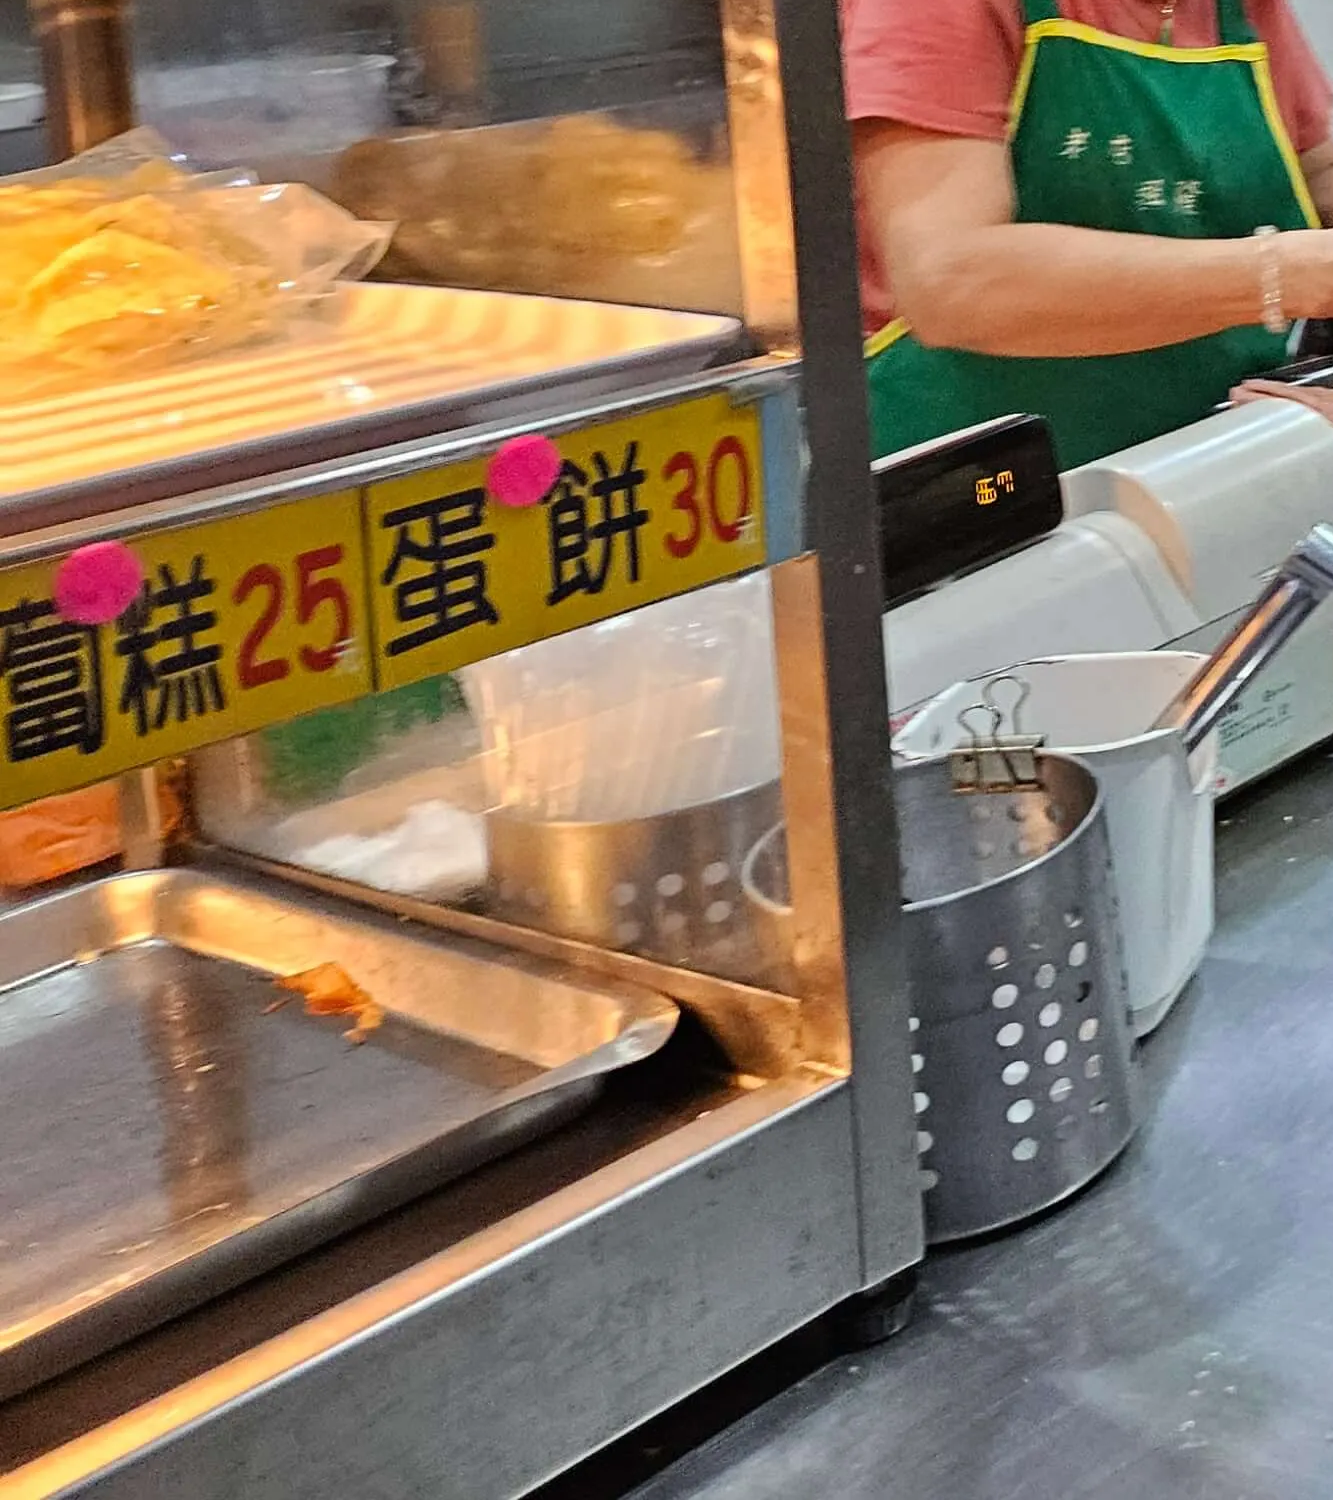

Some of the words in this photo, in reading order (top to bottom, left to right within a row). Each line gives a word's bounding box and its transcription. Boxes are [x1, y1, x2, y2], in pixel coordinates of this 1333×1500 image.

[230, 543, 356, 692] 25
[380, 440, 652, 657] 蛋餅
[663, 435, 752, 560] 30
